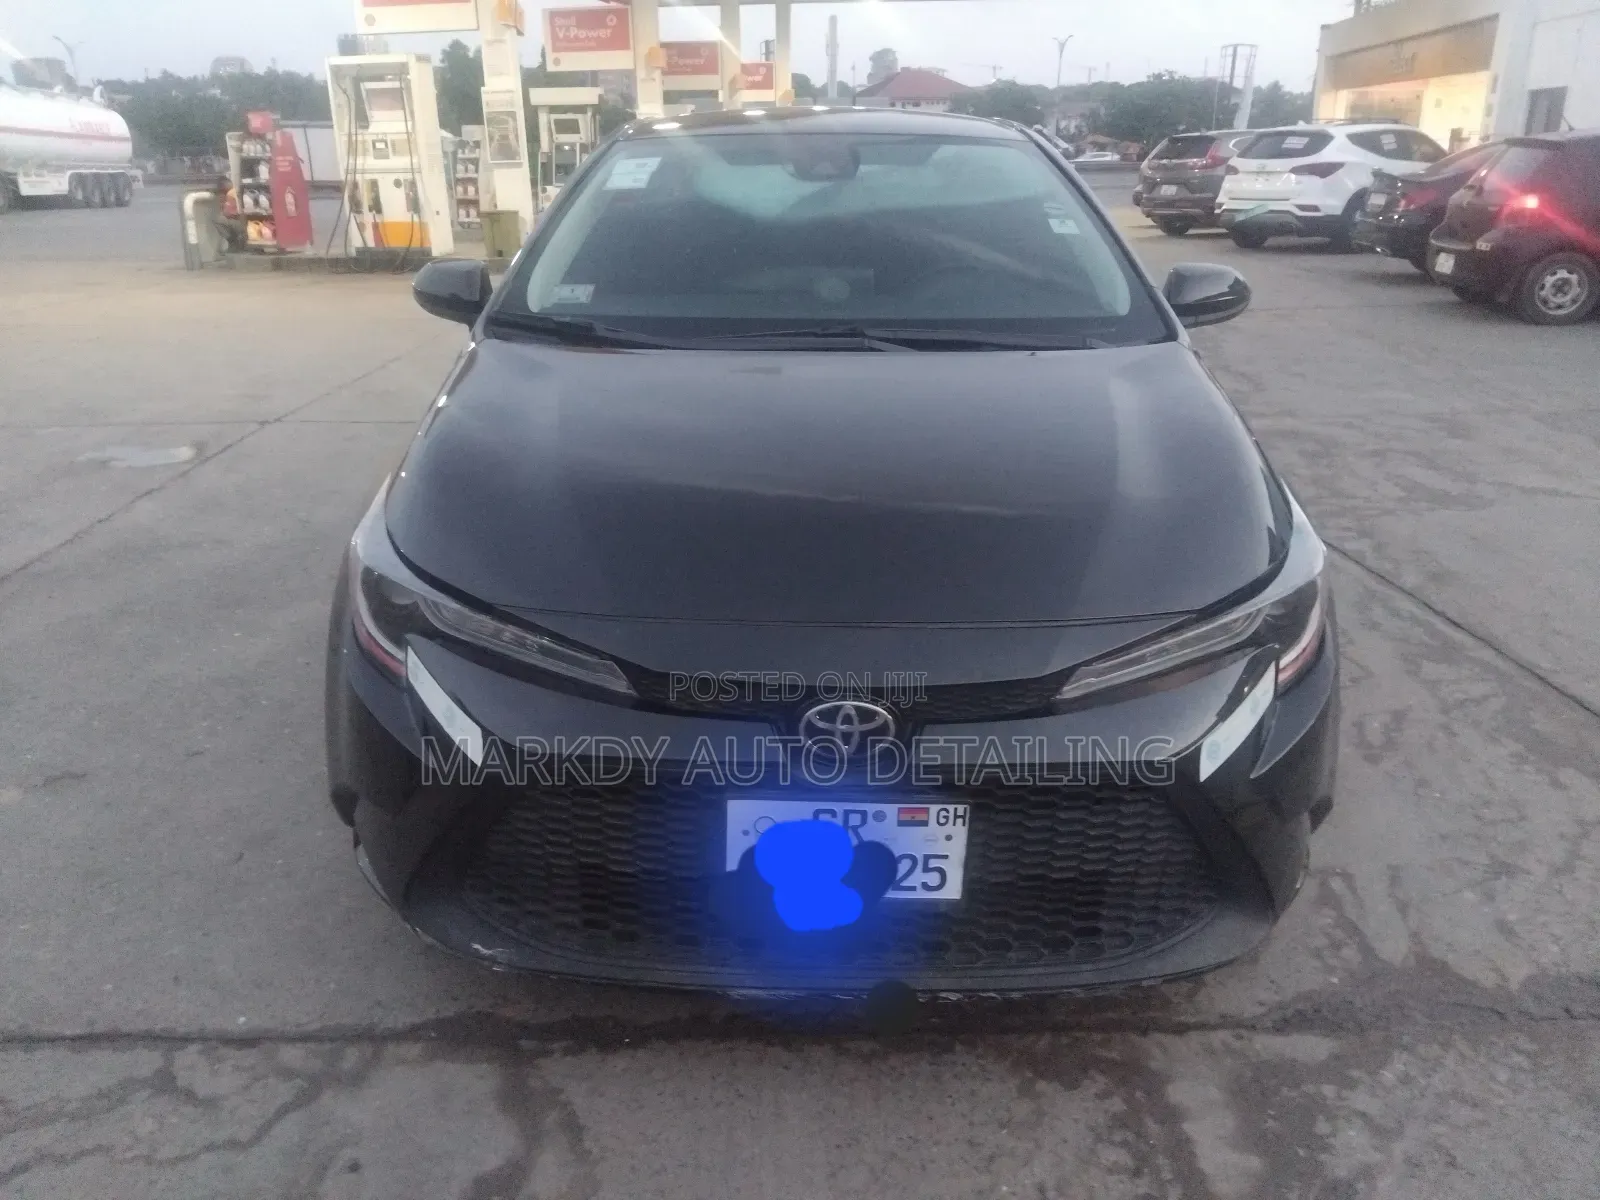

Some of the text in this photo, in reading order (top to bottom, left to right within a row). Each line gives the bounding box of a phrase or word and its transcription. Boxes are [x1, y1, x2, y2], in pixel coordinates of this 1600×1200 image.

[555, 27, 612, 39] V-Power
[667, 56, 706, 65] -Power
[936, 807, 967, 827] GH
